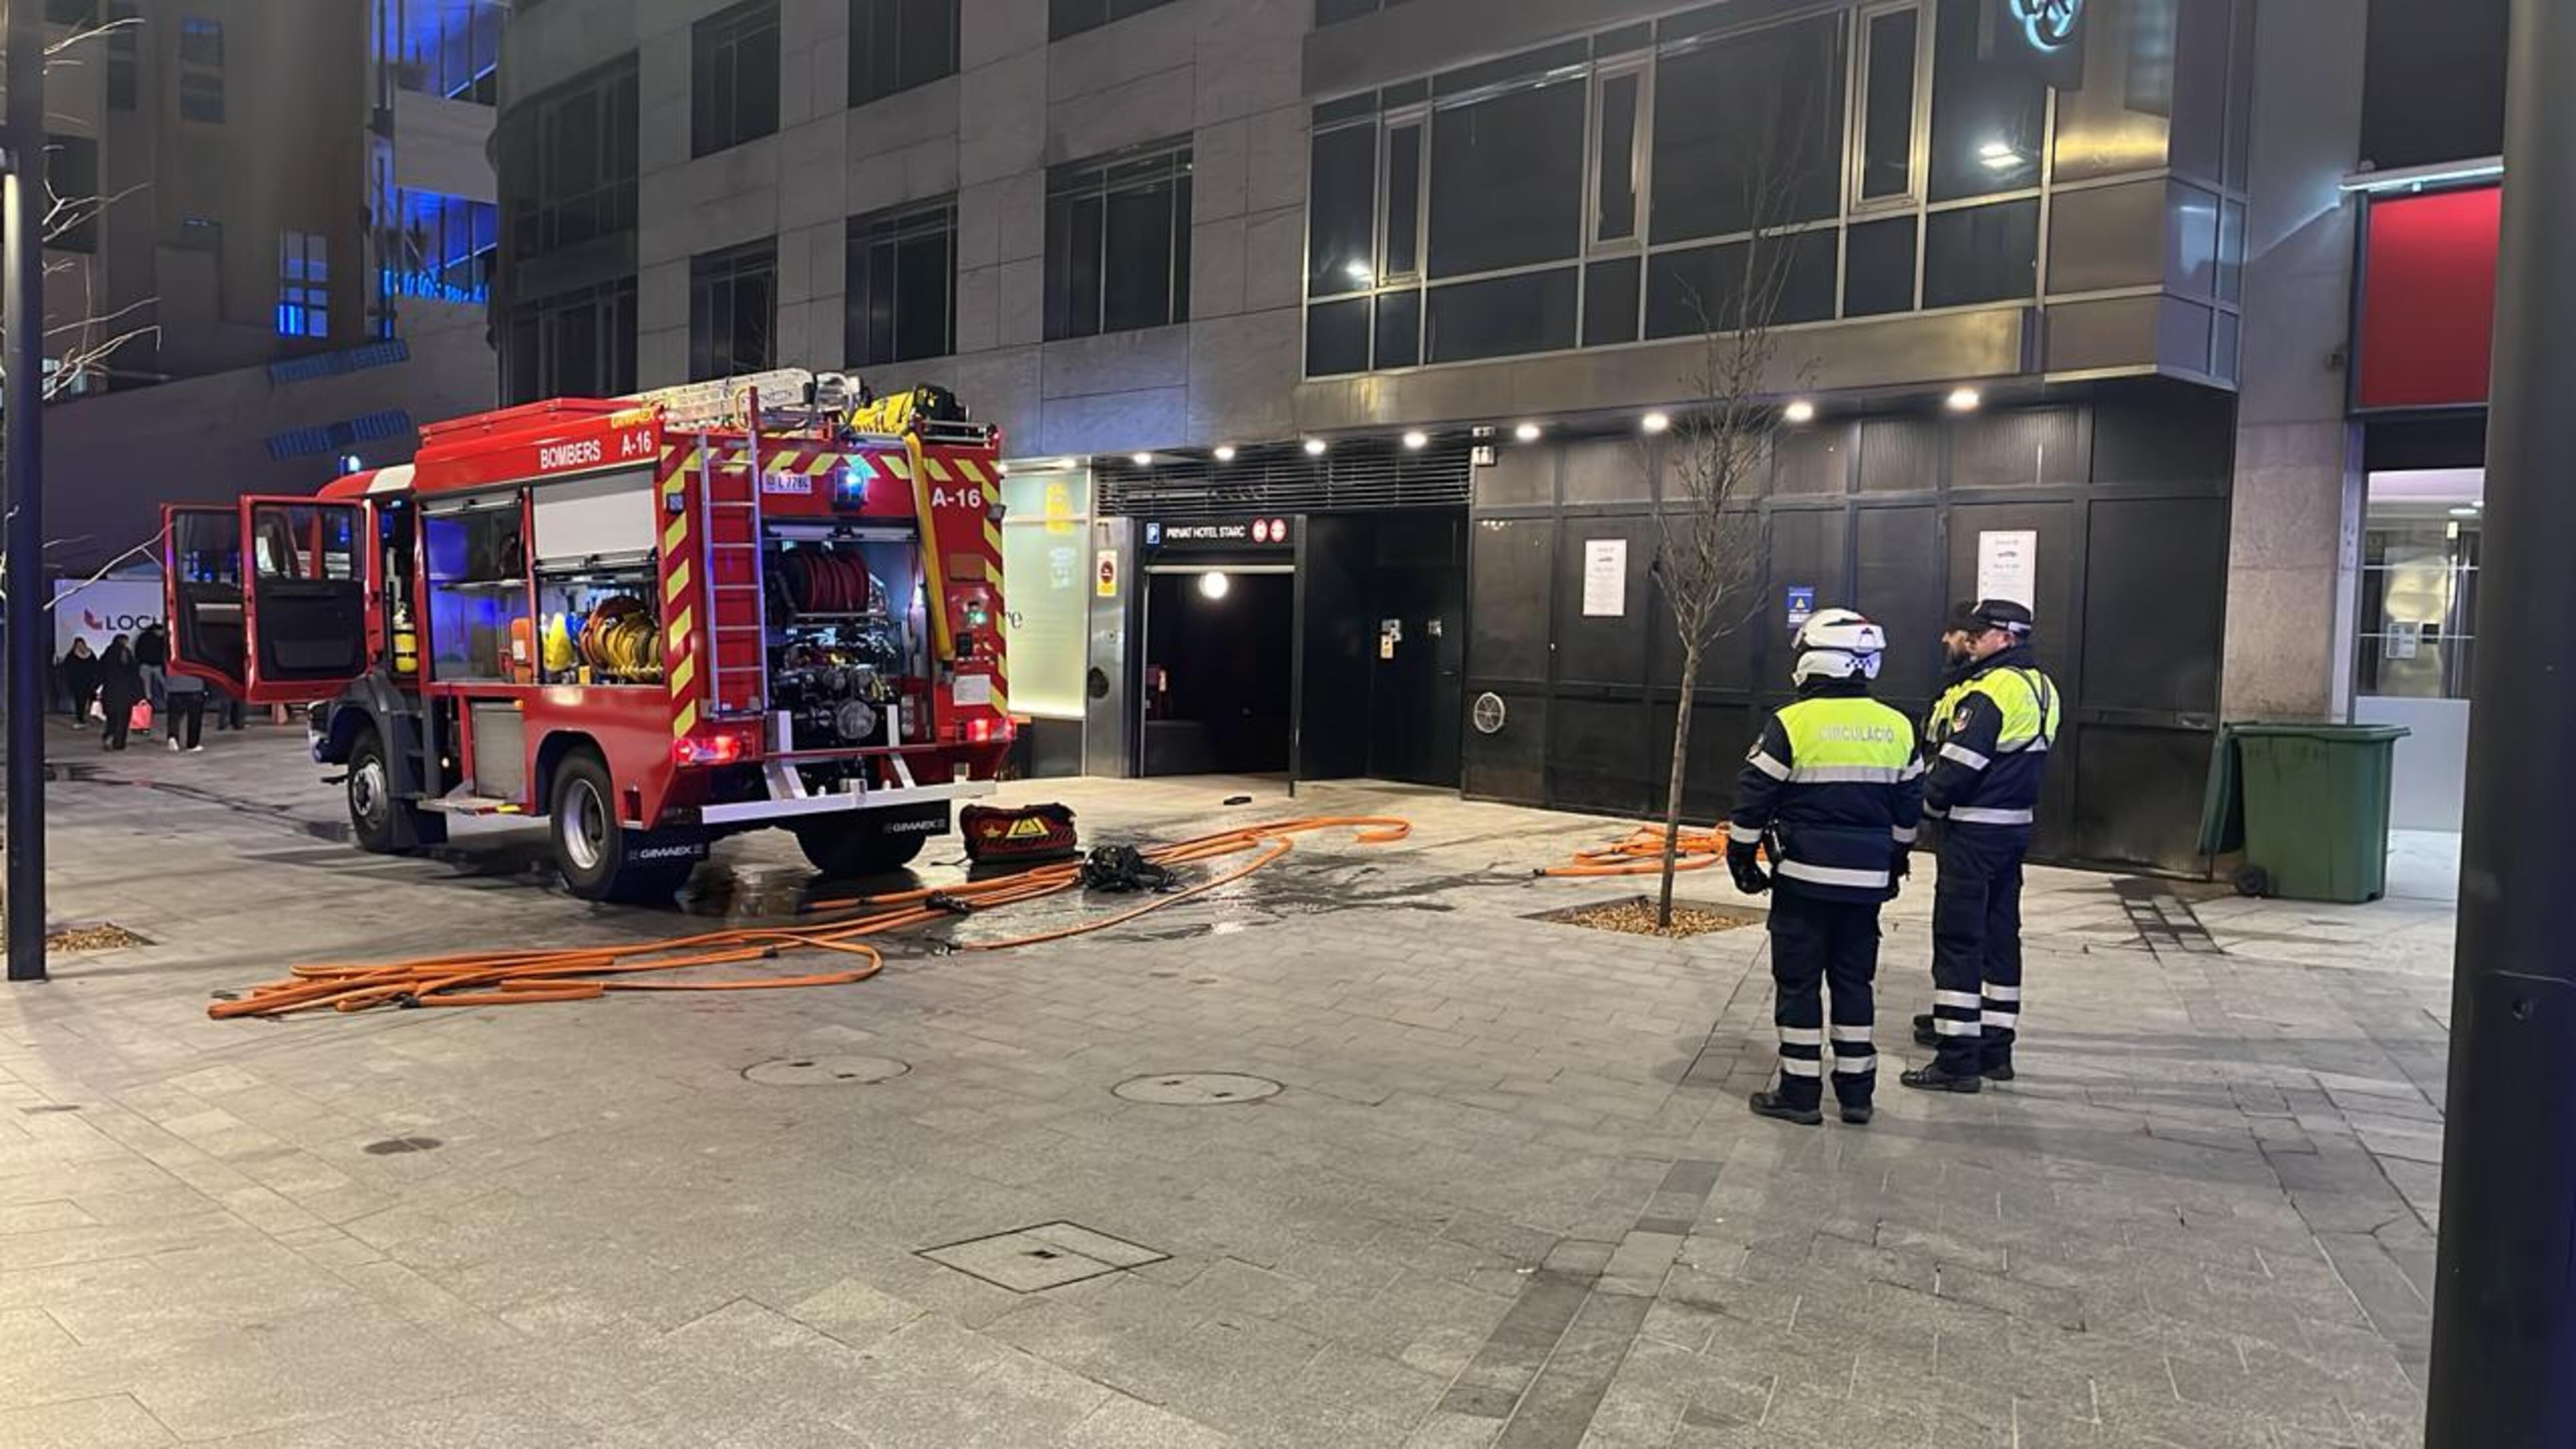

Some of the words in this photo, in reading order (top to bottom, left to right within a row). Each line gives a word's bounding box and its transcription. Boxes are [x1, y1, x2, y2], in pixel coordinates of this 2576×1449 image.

[540, 440, 601, 469] BOMBERS
[621, 430, 651, 457] A-16
[932, 487, 981, 508] A-16
[1193, 527, 1218, 537] HOTEL
